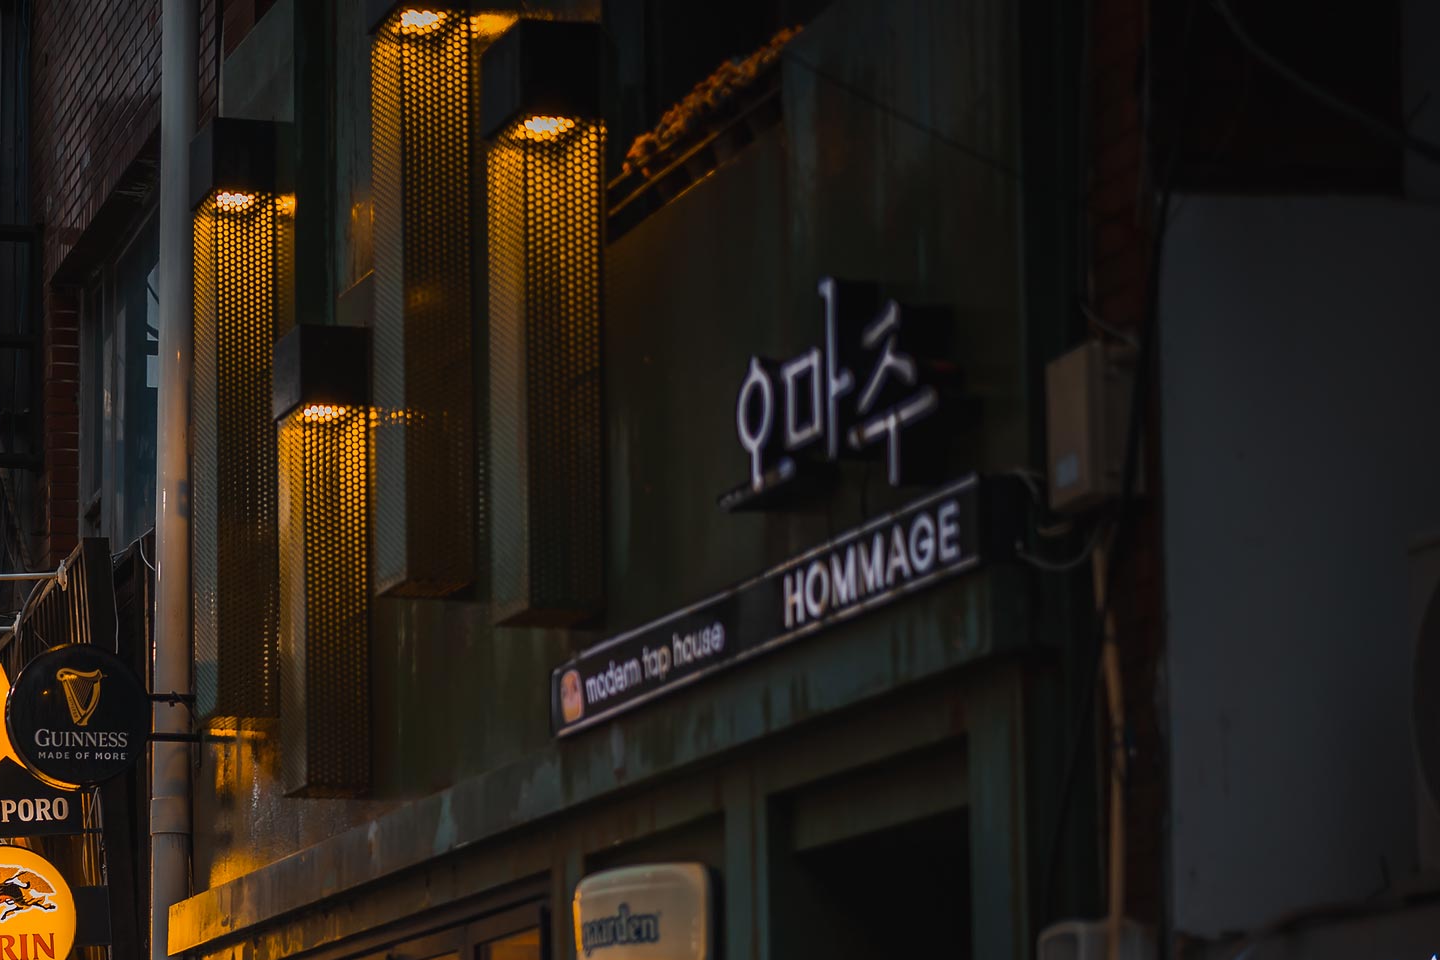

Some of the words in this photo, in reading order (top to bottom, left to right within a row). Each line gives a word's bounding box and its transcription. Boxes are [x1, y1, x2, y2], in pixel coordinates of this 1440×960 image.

[716, 275, 940, 511] 오마주
[783, 500, 961, 630] HOMMAGE
[586, 657, 642, 705] modern
[642, 645, 671, 684] tap
[672, 620, 726, 669] house
[34, 728, 128, 748] GUINNESS
[38, 751, 70, 760] MADE
[75, 752, 91, 760] OF
[95, 752, 127, 761] MORE
